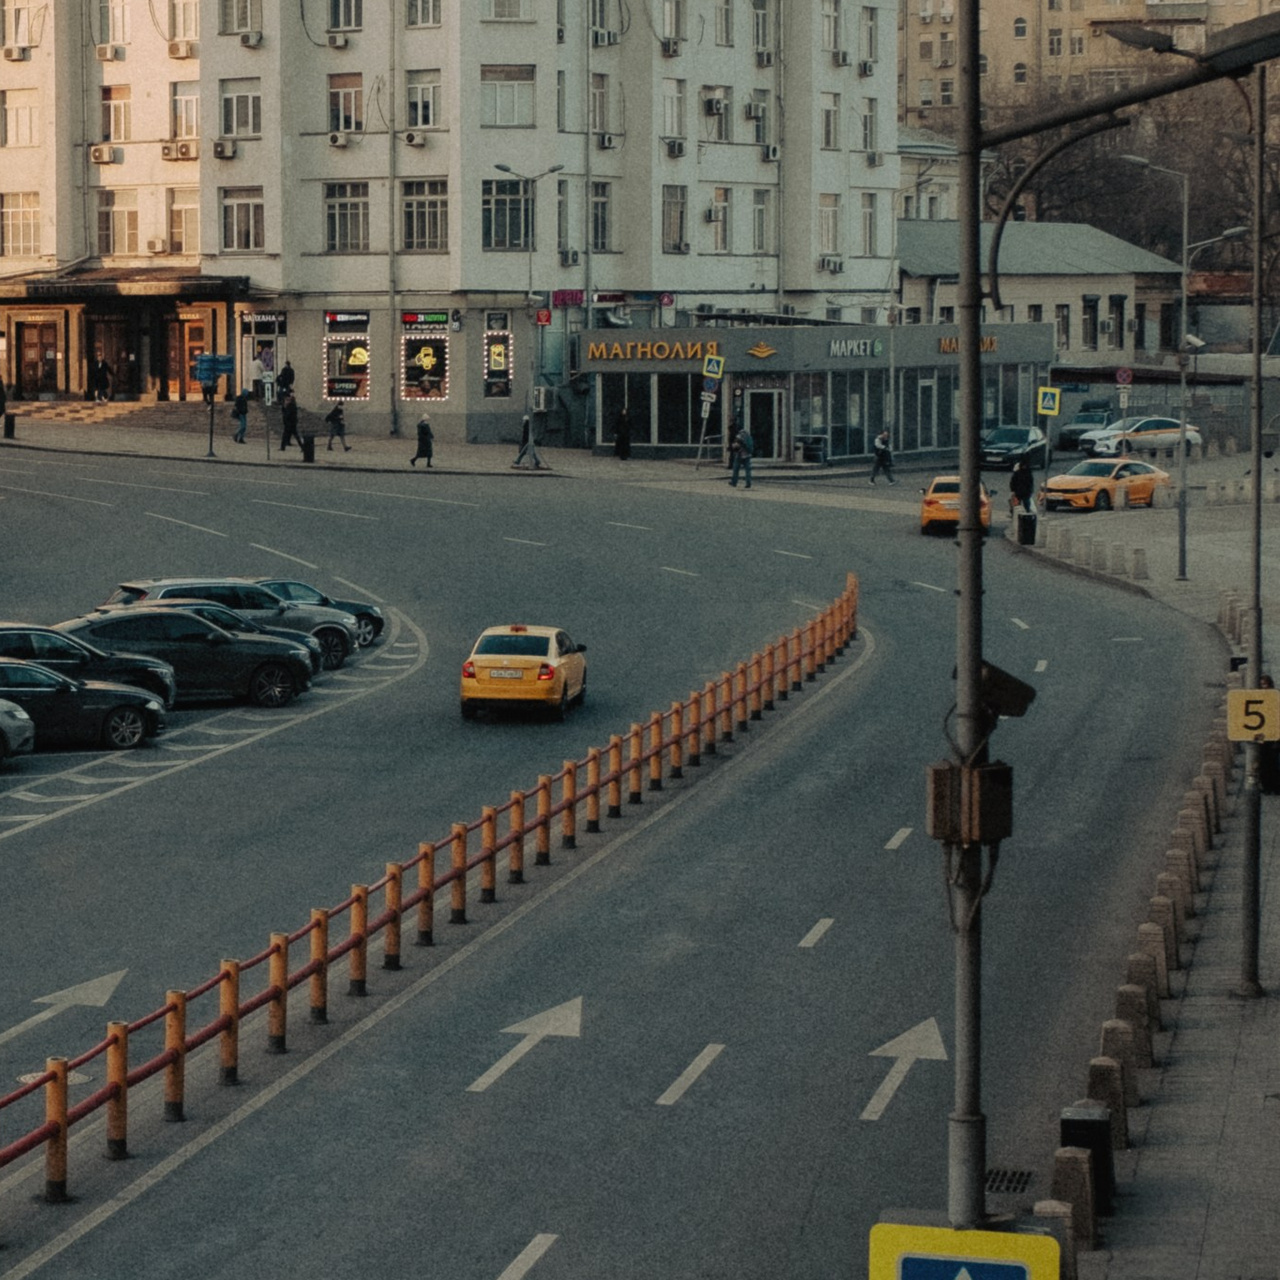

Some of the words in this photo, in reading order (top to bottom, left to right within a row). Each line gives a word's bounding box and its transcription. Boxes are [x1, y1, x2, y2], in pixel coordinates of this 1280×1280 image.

[588, 340, 718, 360] МАГНОЛИЯ
[830, 339, 872, 357] МАРКЕТ
[1243, 700, 1265, 731] 5
